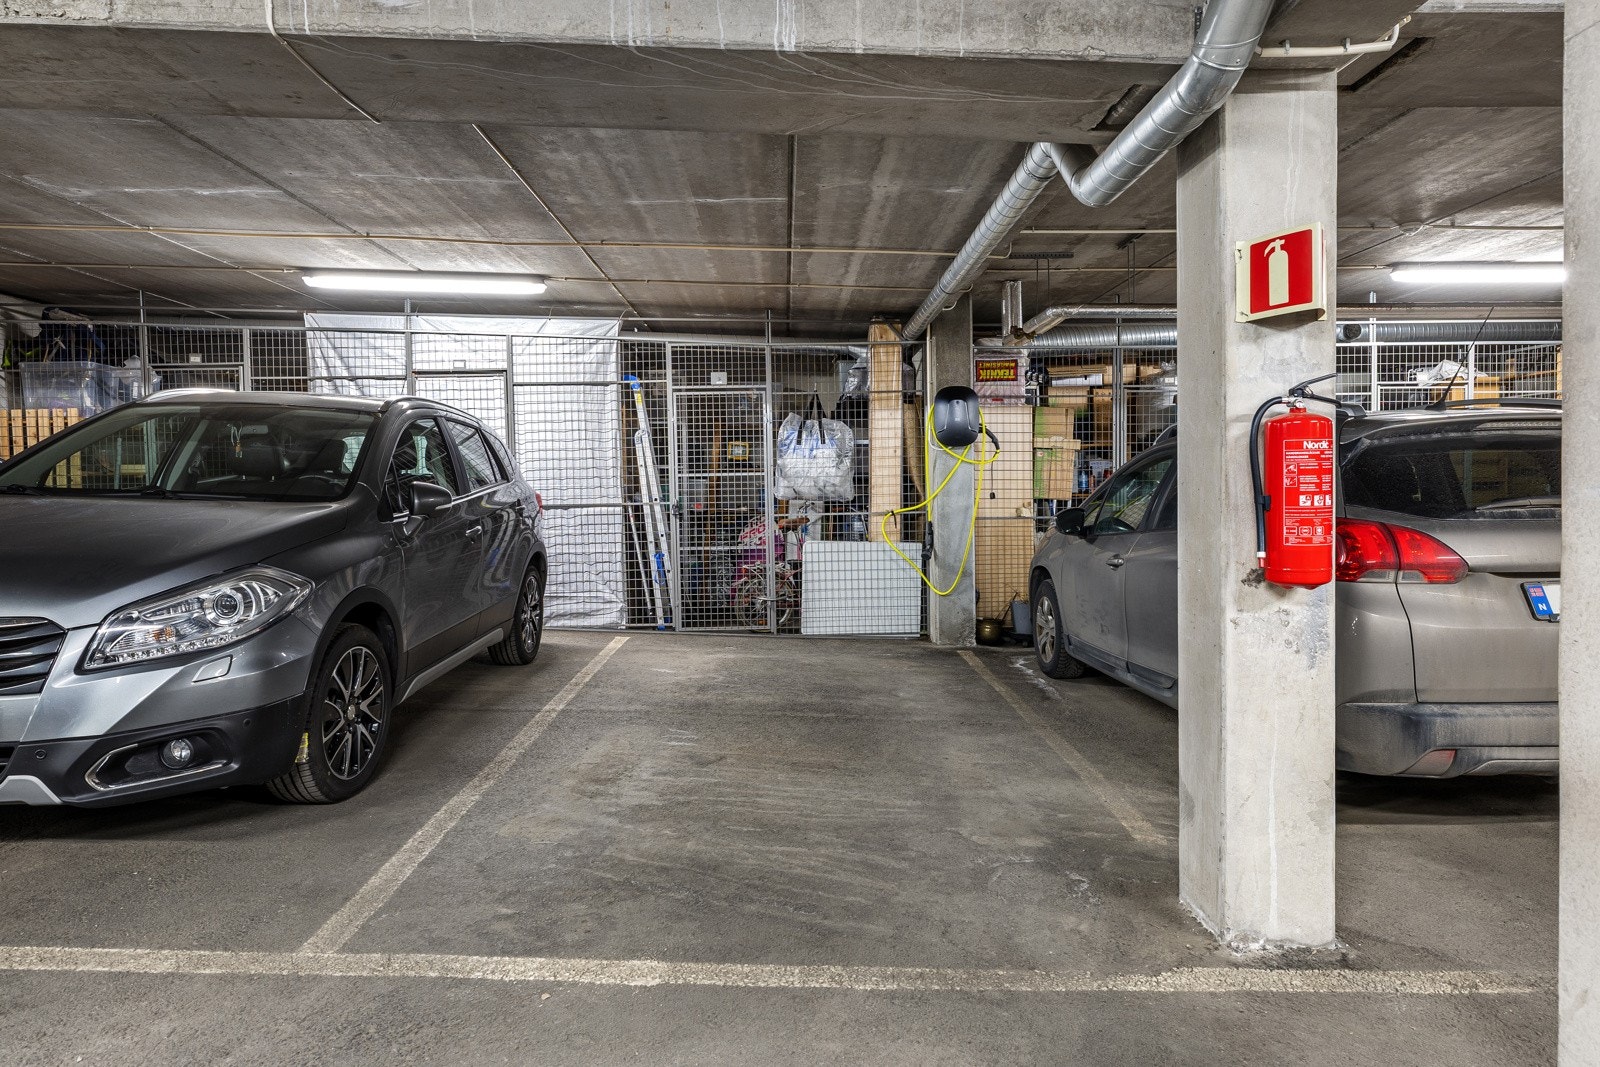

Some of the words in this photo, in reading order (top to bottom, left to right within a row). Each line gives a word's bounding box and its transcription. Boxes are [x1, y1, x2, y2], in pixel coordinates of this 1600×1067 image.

[979, 369, 1016, 379] TEKNIK
[1303, 440, 1329, 449] Nordic
[1537, 603, 1548, 611] N
